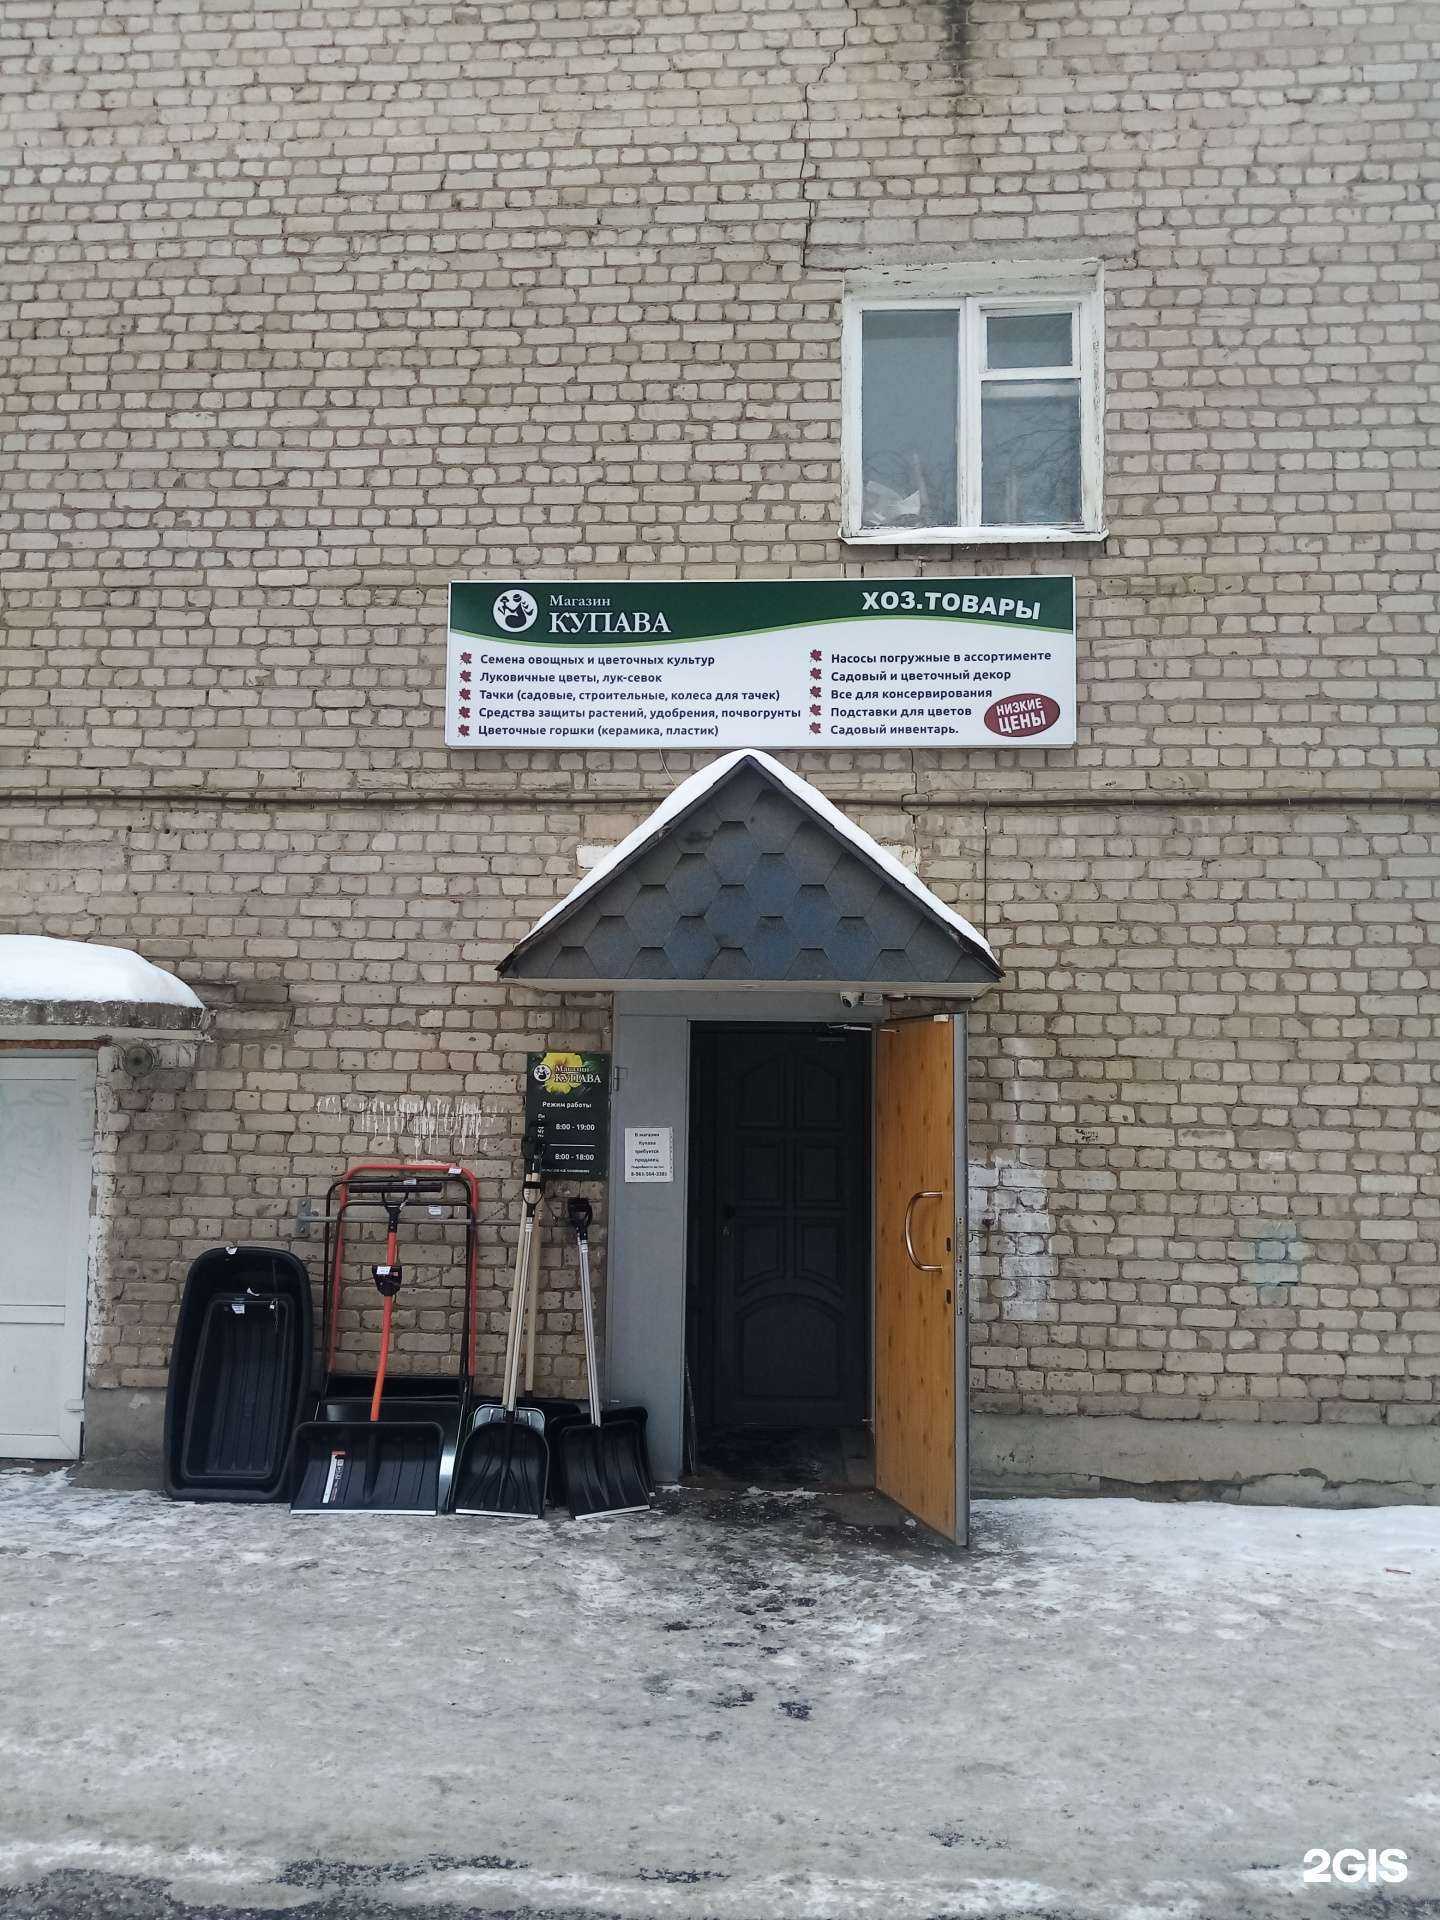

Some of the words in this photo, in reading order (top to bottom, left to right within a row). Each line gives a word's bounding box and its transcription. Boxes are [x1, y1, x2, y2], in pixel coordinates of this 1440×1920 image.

[549, 594, 611, 607] Магазин
[861, 591, 1041, 620] ХОЗ.ТОВАРЫ
[548, 612, 671, 633] КУПАВА
[480, 655, 525, 665] Семена
[528, 656, 584, 666] овощных
[587, 656, 594, 665] и
[598, 656, 664, 667] цветочных
[667, 656, 715, 668] культур
[831, 654, 877, 664] Насосы
[880, 654, 950, 665] погружные
[953, 654, 961, 662] в
[964, 651, 1051, 664] ассортименте
[480, 672, 555, 684] Луковичные
[559, 673, 600, 684] цветы,
[602, 674, 662, 684] лук-севок
[831, 671, 887, 682] Садовый
[901, 670, 970, 682] цветочный
[973, 670, 1011, 682] декор
[480, 690, 514, 700] Тачки
[517, 690, 576, 702] (садовые,
[579, 691, 668, 702] строительные,
[671, 691, 712, 700] колеса
[715, 691, 739, 702] для
[742, 690, 780, 703] тачек)
[831, 690, 851, 700] Все
[855, 691, 879, 701] для
[882, 688, 992, 701] консервирования
[831, 707, 897, 717] Подставки
[901, 708, 924, 718] для
[927, 707, 972, 718] цветов
[996, 698, 1043, 715] НИЗКИЕ
[479, 707, 535, 720] Средства
[538, 708, 586, 720] защиты
[589, 707, 647, 720] растений,
[650, 708, 718, 720] удобрения,
[722, 709, 801, 720] почвогрунты
[998, 710, 1046, 734] ЦЕНЫ
[478, 726, 546, 738] Цветочные
[550, 727, 595, 736] горшки
[598, 725, 663, 738] (керамика,
[666, 725, 719, 738] пластик)
[831, 725, 887, 736] Садовый
[890, 724, 959, 736] инвентарь.
[555, 1073, 602, 1083] КУПАВА
[566, 1101, 592, 1109] работы
[555, 1123, 571, 1131] 8:00
[576, 1123, 595, 1132] 19:00
[554, 1153, 570, 1161] 8:00
[575, 1153, 595, 1161] 18:00
